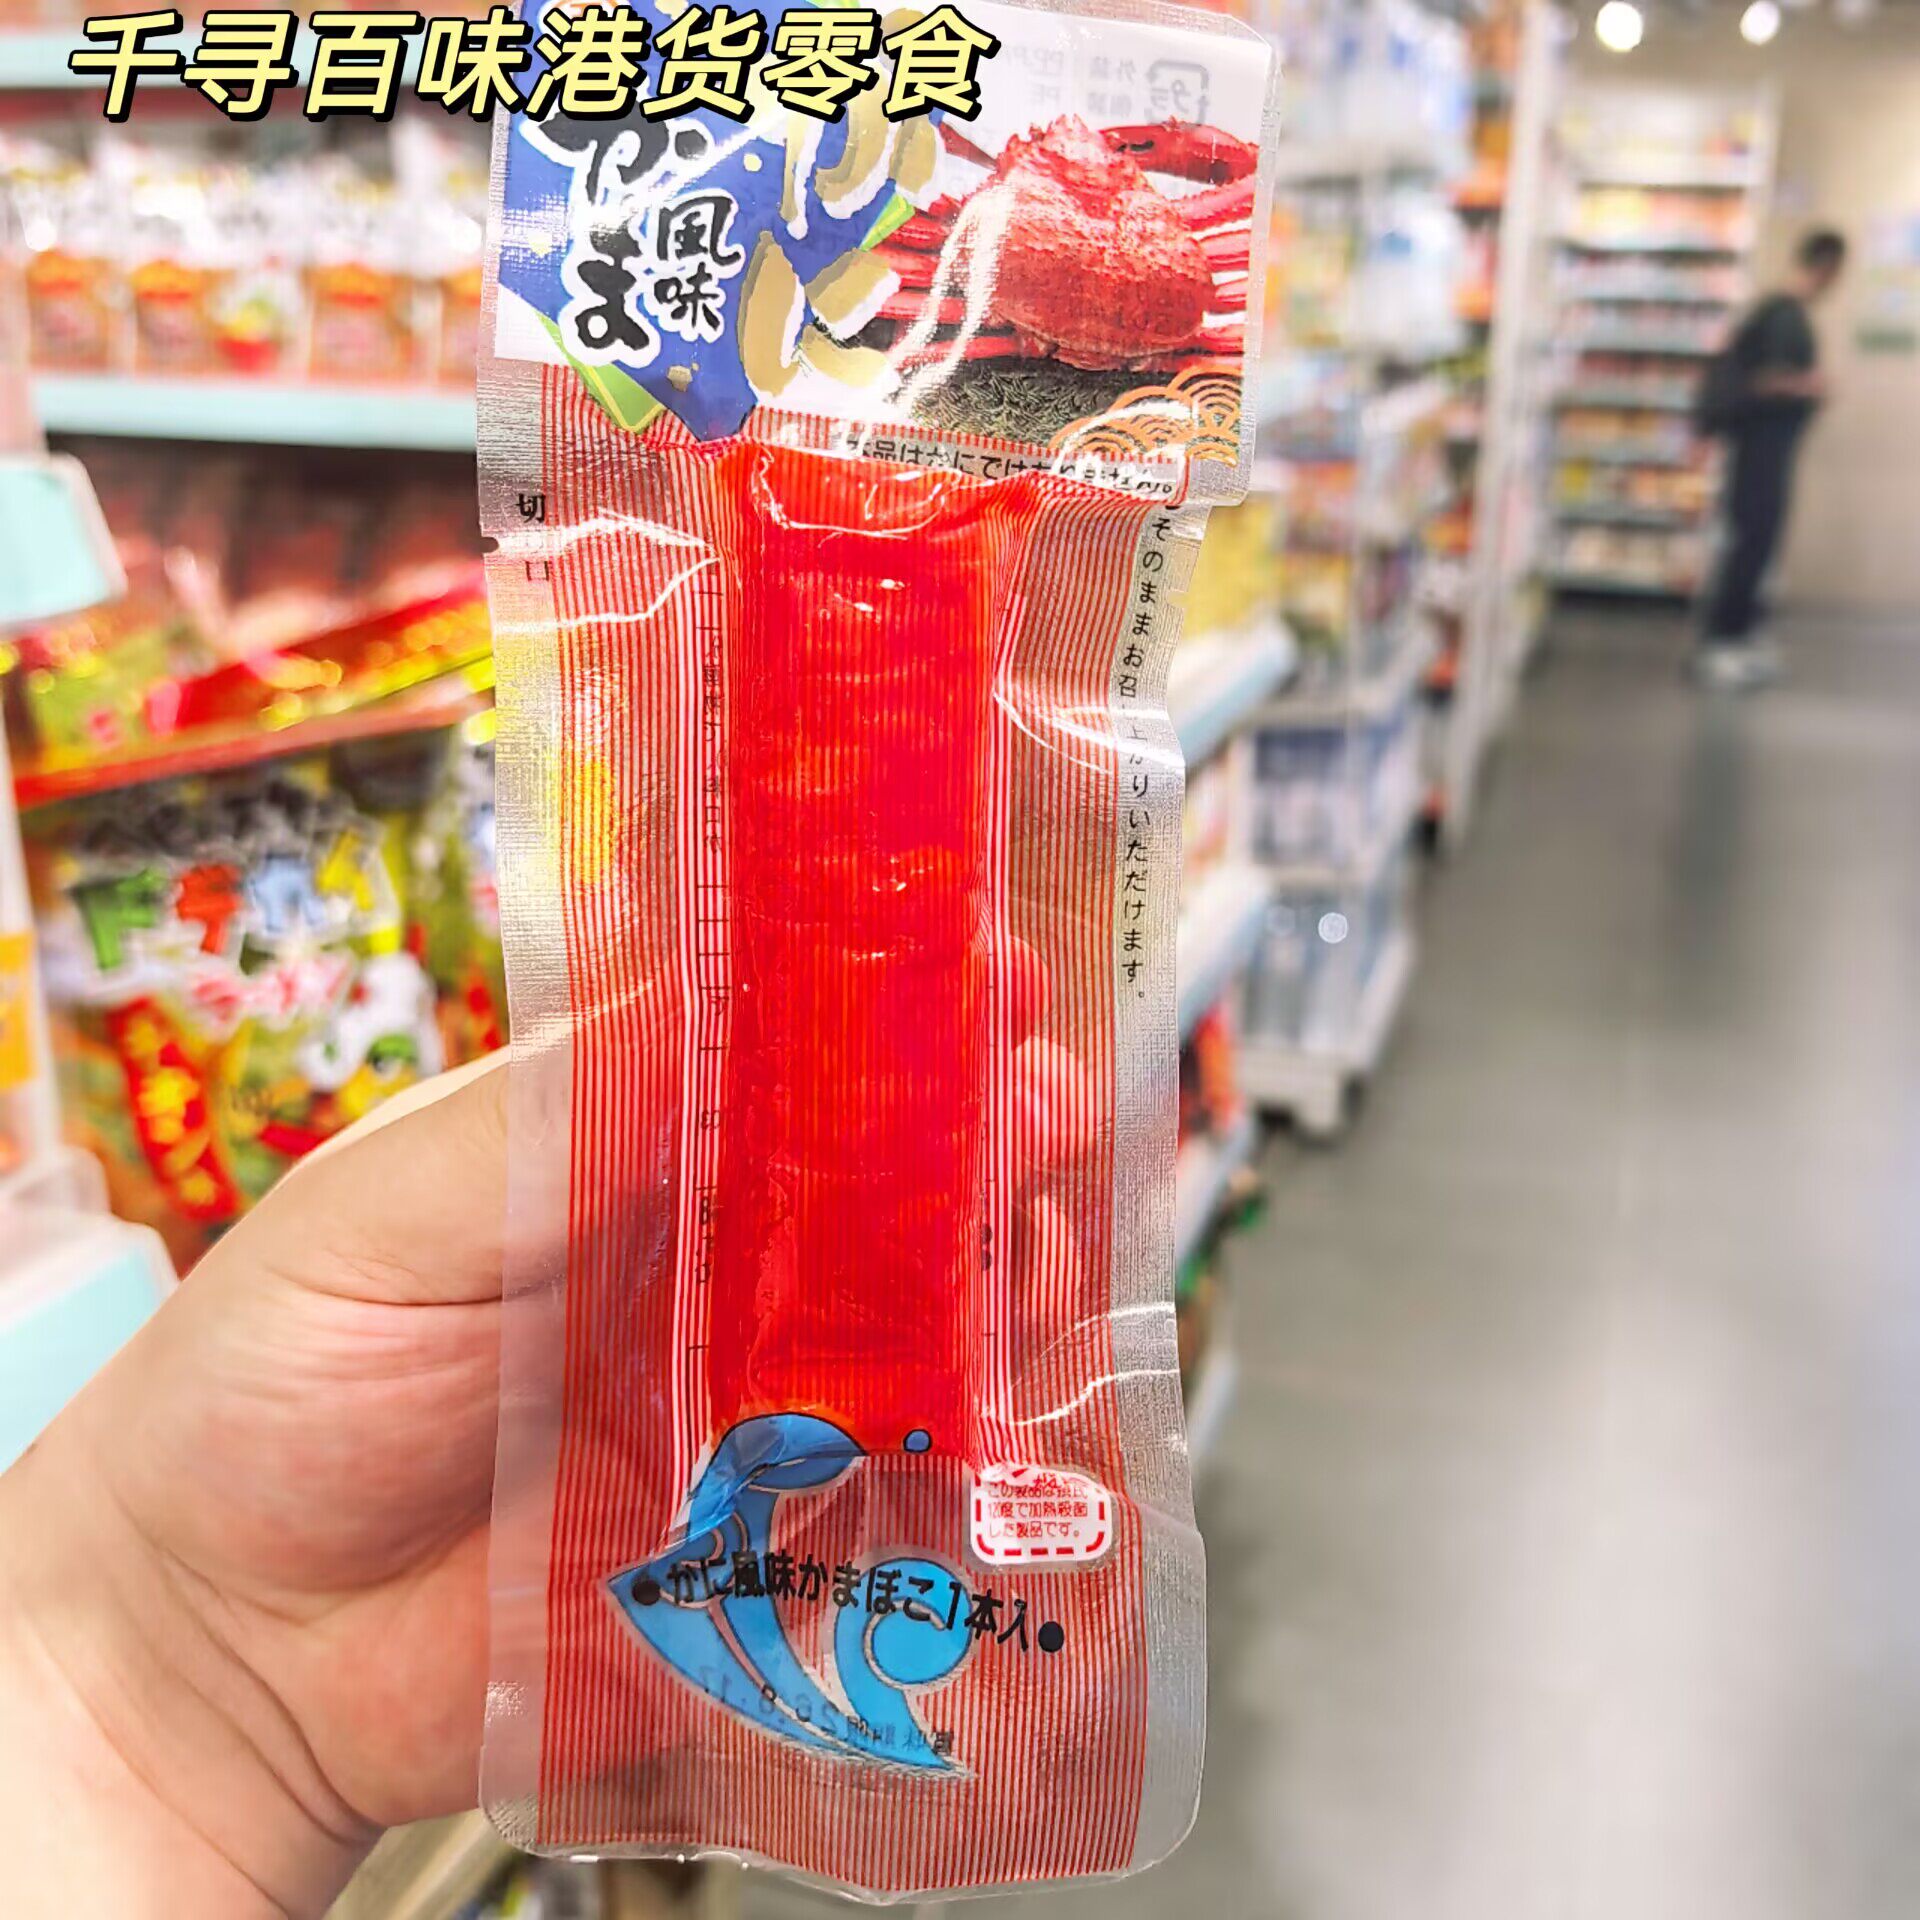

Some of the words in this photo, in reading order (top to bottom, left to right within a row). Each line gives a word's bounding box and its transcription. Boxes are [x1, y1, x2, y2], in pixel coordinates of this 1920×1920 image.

[653, 195, 742, 332] 風味
[989, 1520, 1081, 1539] した製品です。
